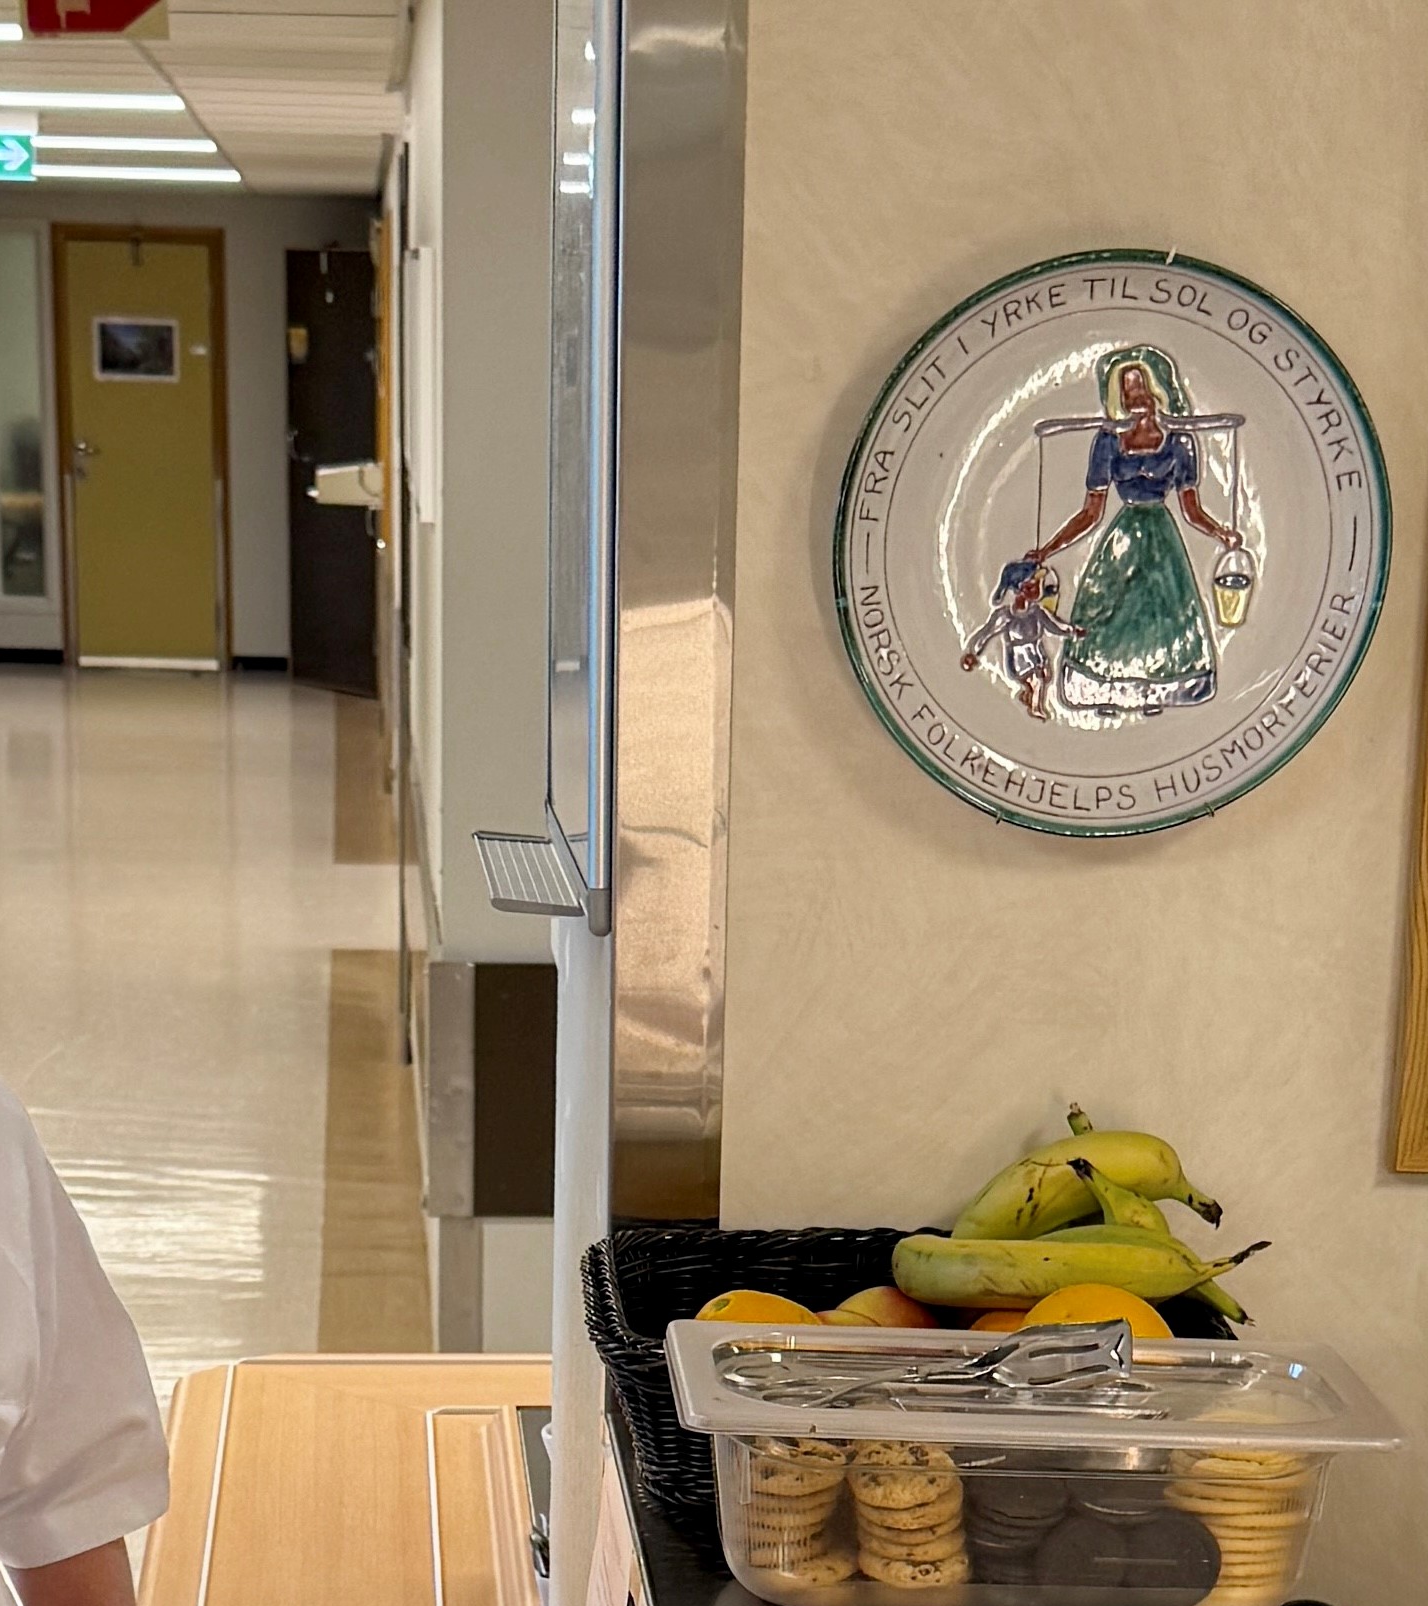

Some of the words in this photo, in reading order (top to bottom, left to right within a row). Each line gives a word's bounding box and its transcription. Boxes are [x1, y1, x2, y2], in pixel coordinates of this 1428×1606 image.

[859, 449, 896, 523] FRA
[892, 361, 948, 434] SLIT
[955, 333, 972, 355] I
[981, 283, 1068, 339] YRKE
[1082, 276, 1140, 302] TIL
[1148, 277, 1215, 319] SOL
[1226, 308, 1273, 347] OG
[1272, 348, 1365, 494] STYRKE
[859, 583, 916, 701] NORSK
[910, 704, 1138, 812] FOLKEHJELPS
[1153, 592, 1358, 802] HUSMORFERIER
